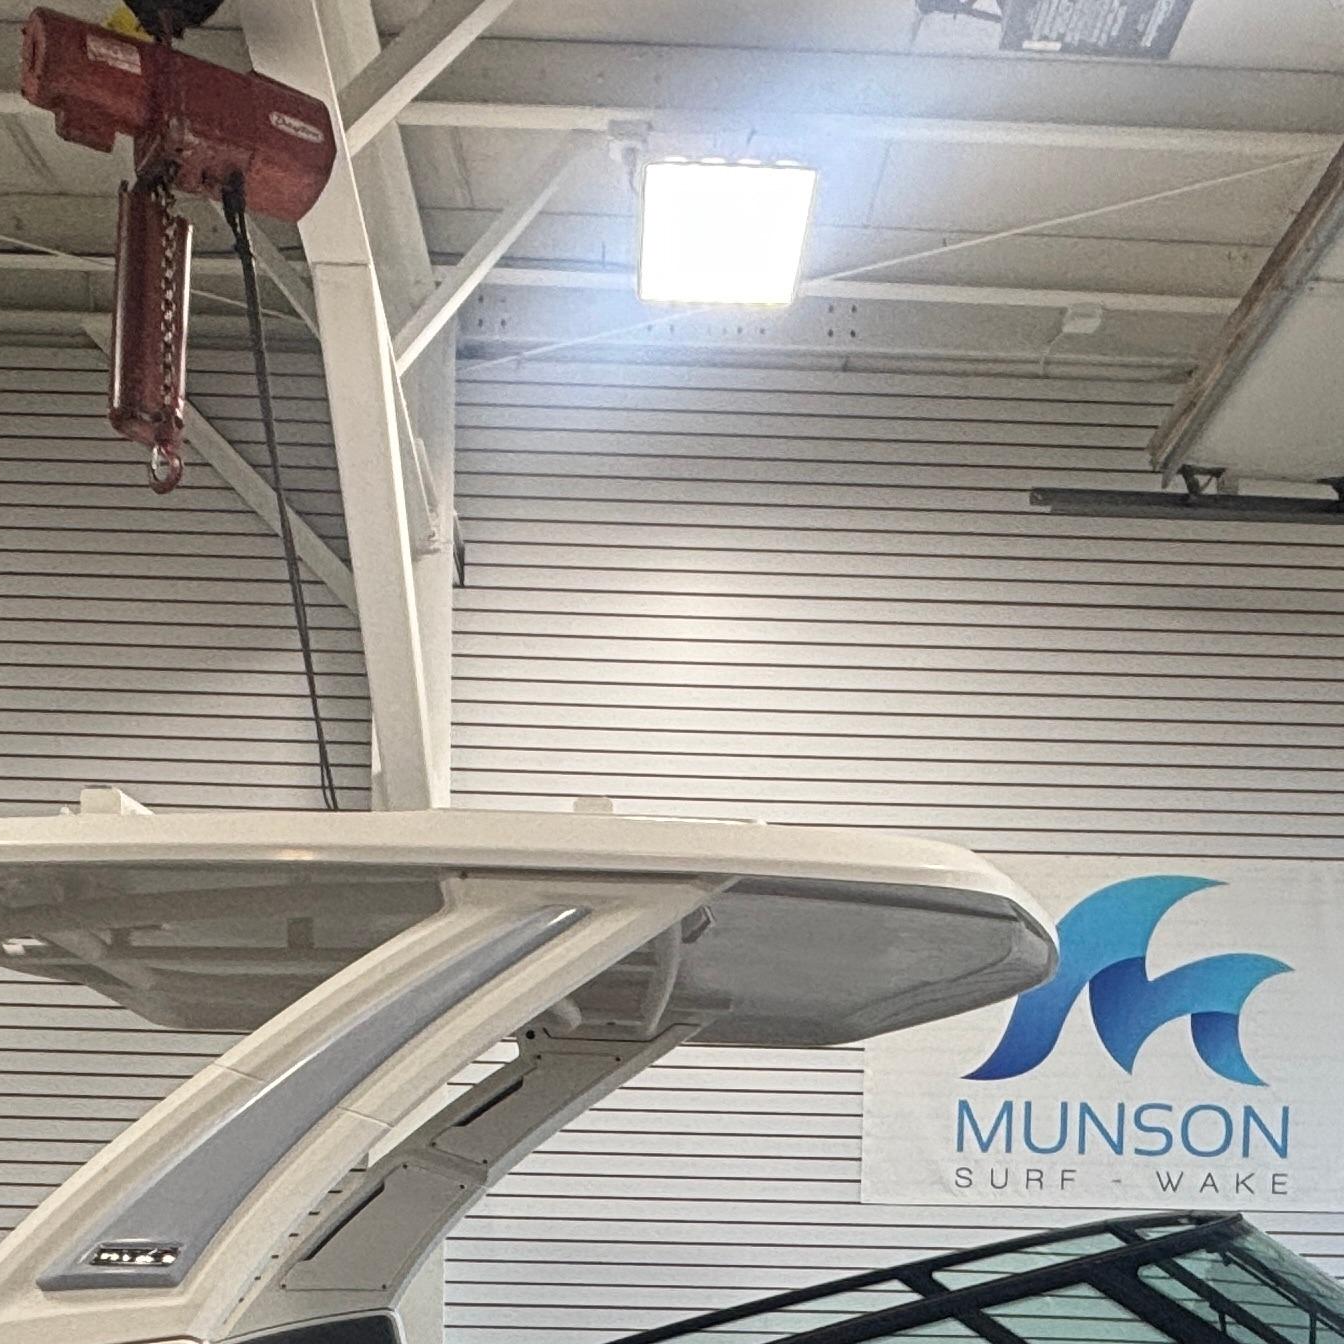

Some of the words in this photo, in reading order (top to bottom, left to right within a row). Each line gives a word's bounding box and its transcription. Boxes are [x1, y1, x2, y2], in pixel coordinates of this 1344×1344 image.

[956, 1098, 1290, 1159] MUNSON
[954, 1166, 1078, 1191] SURF
[1155, 1170, 1289, 1196] WAKE
